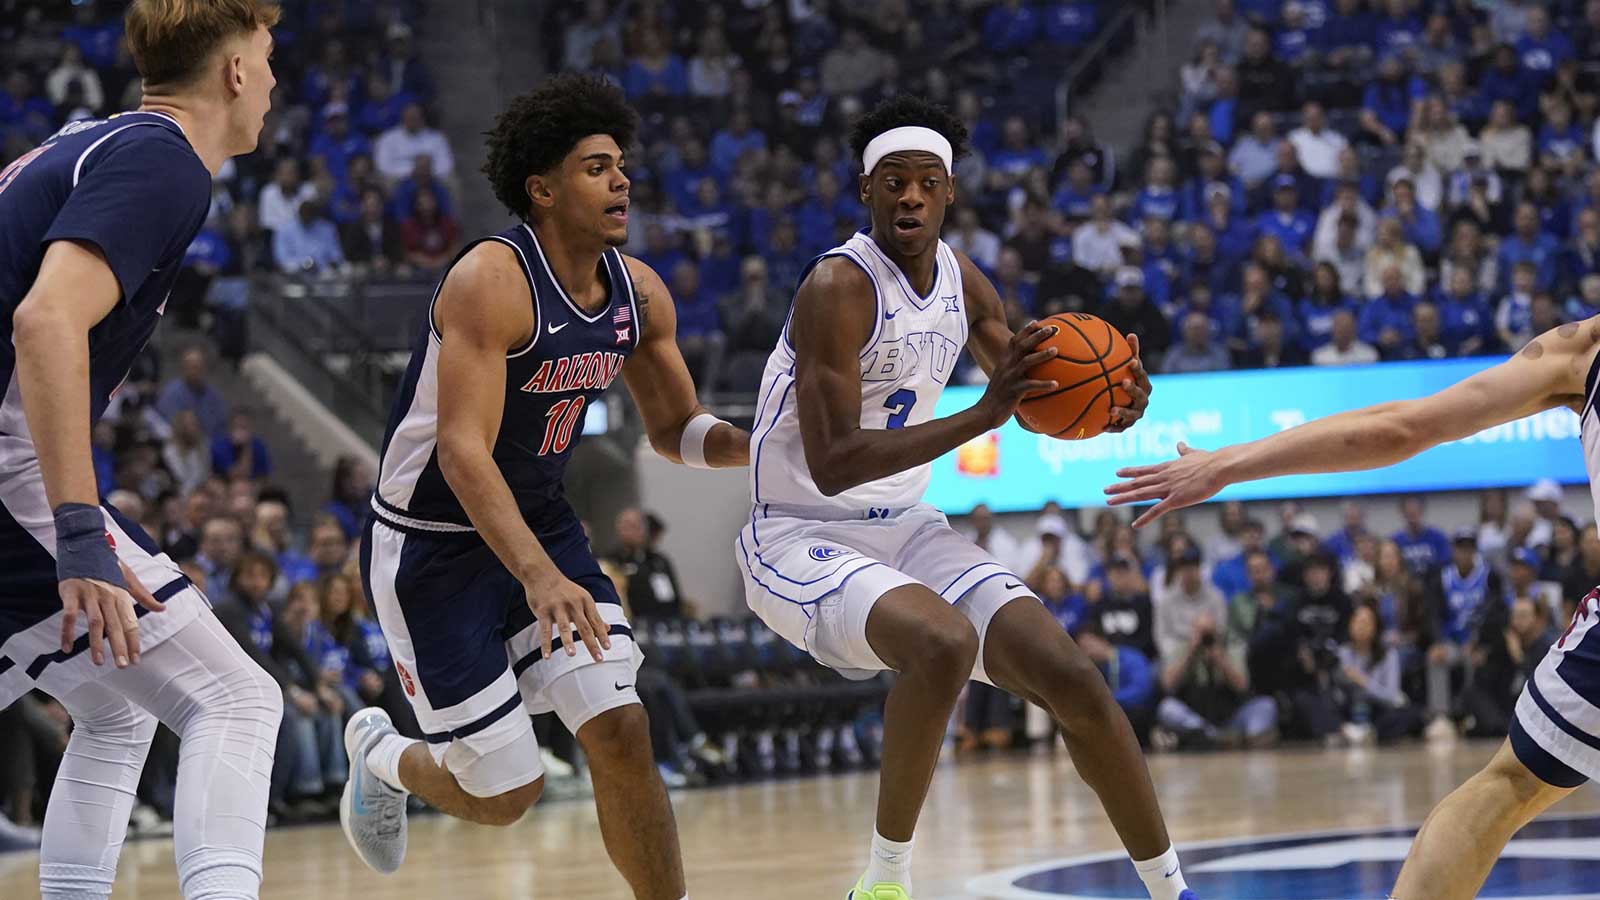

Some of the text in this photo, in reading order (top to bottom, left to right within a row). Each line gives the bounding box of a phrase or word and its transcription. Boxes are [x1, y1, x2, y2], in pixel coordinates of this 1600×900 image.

[520, 351, 625, 393] ARIZONA
[861, 331, 957, 385] BYU
[537, 395, 586, 456] 10
